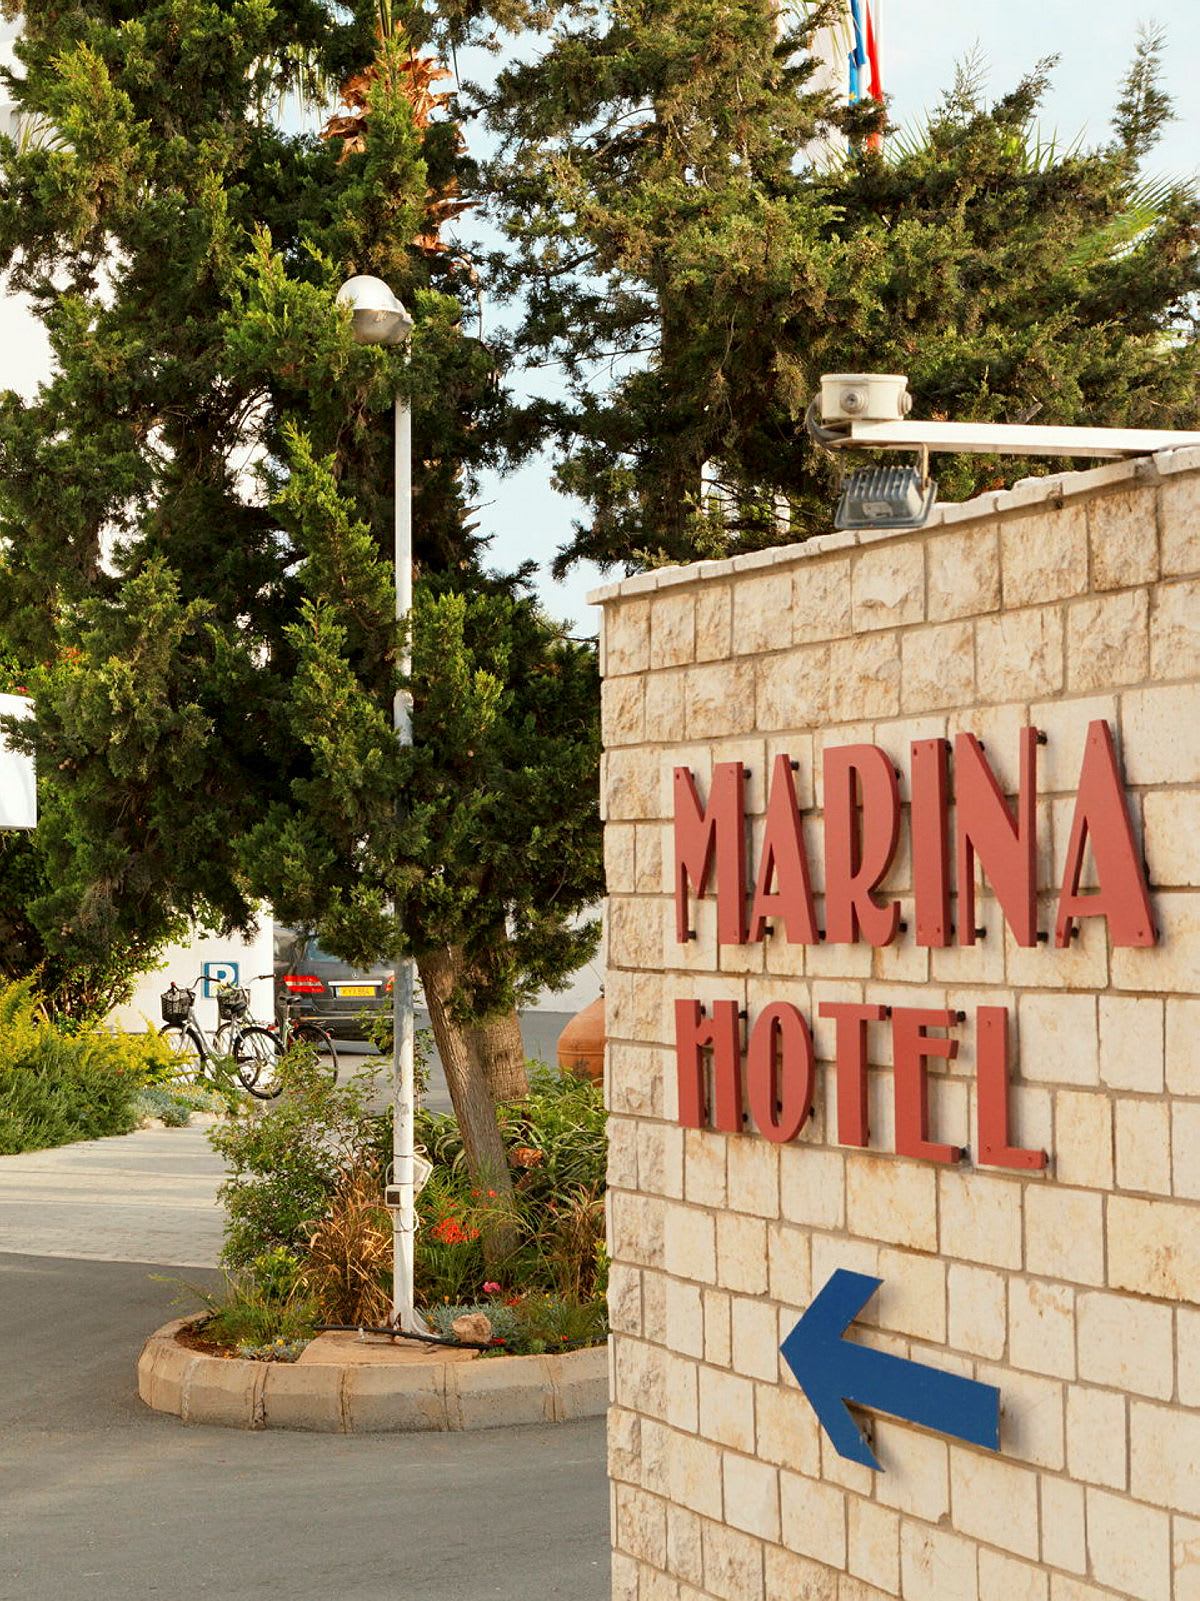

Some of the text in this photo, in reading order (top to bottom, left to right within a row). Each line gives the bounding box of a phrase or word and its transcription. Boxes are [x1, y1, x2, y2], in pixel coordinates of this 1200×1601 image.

[673, 719, 1157, 948] MARINA
[208, 963, 236, 997] P
[673, 999, 1048, 1169] HOTEL
